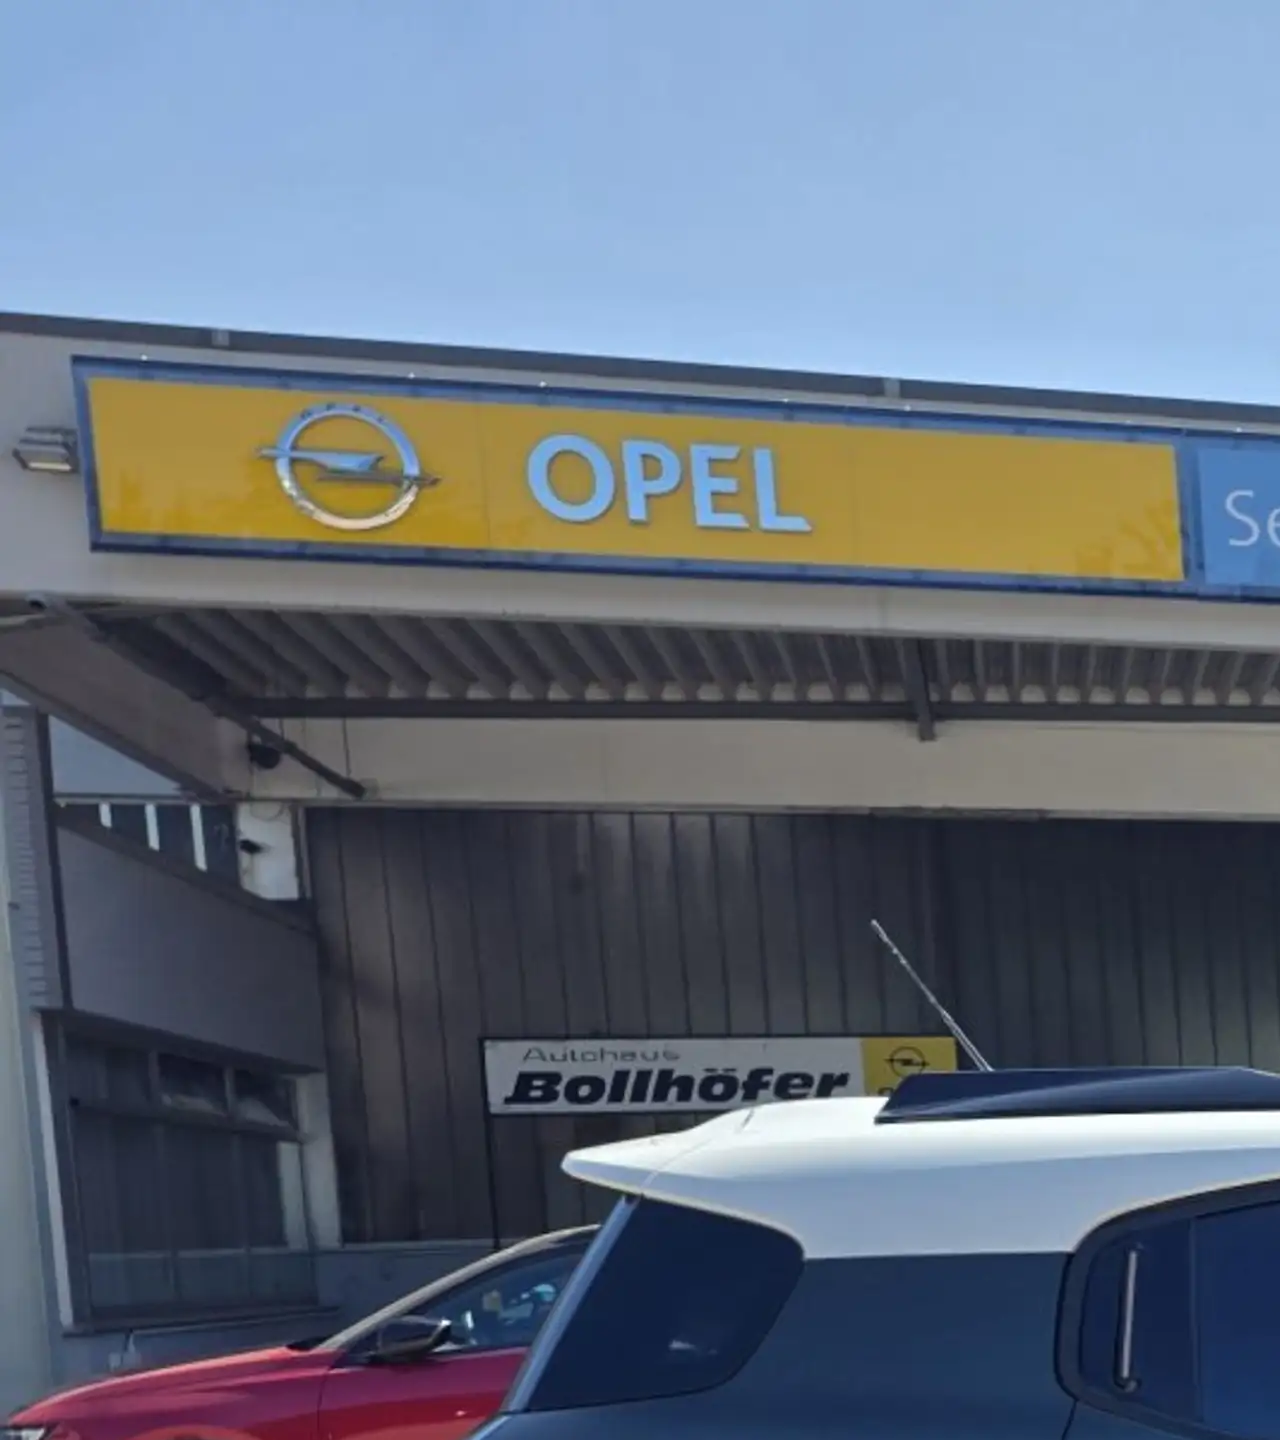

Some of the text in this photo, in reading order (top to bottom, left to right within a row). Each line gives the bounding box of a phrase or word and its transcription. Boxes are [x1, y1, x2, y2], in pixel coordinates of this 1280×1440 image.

[527, 433, 812, 533] OPEL
[522, 1046, 681, 1063] Autohaus
[504, 1067, 850, 1105] Bollhöfer
